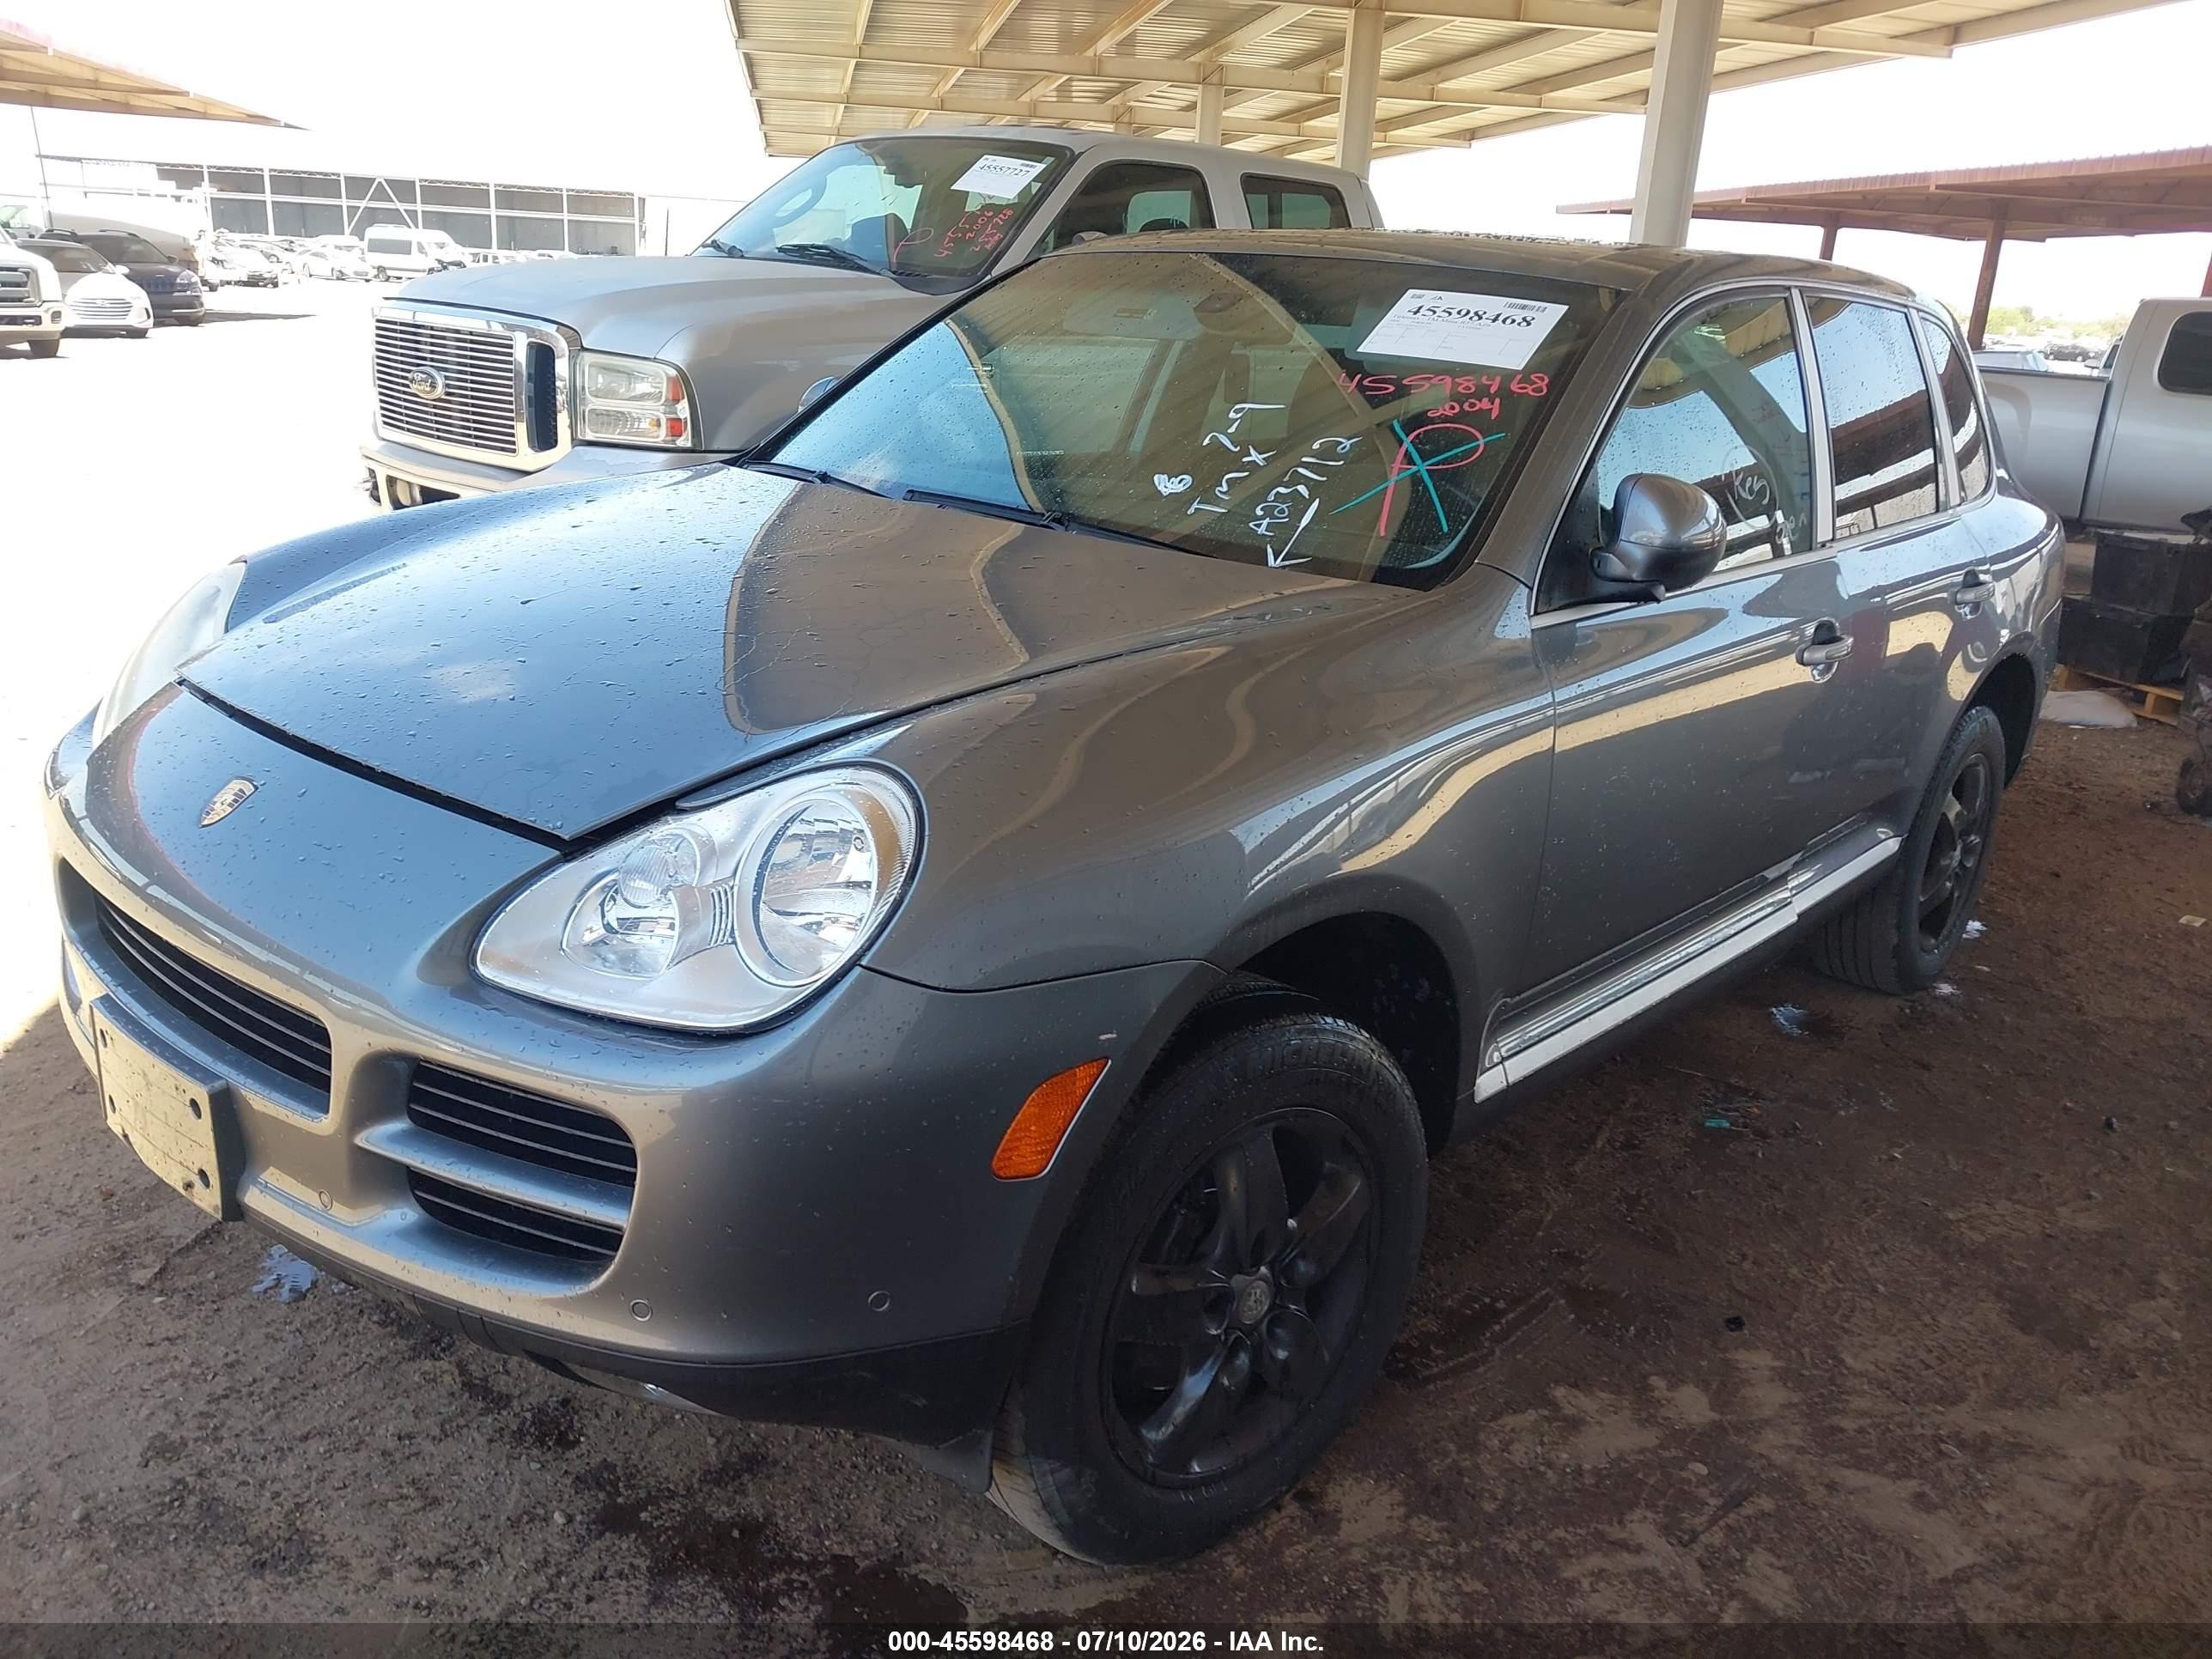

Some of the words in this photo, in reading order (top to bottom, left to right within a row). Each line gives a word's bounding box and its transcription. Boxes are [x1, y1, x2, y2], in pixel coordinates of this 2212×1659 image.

[965, 210, 994, 240] 2006
[1407, 304, 1536, 328] 45598468
[412, 372, 432, 392] Ford
[1338, 372, 1549, 397] 45598468
[1427, 398, 1501, 419] 2004
